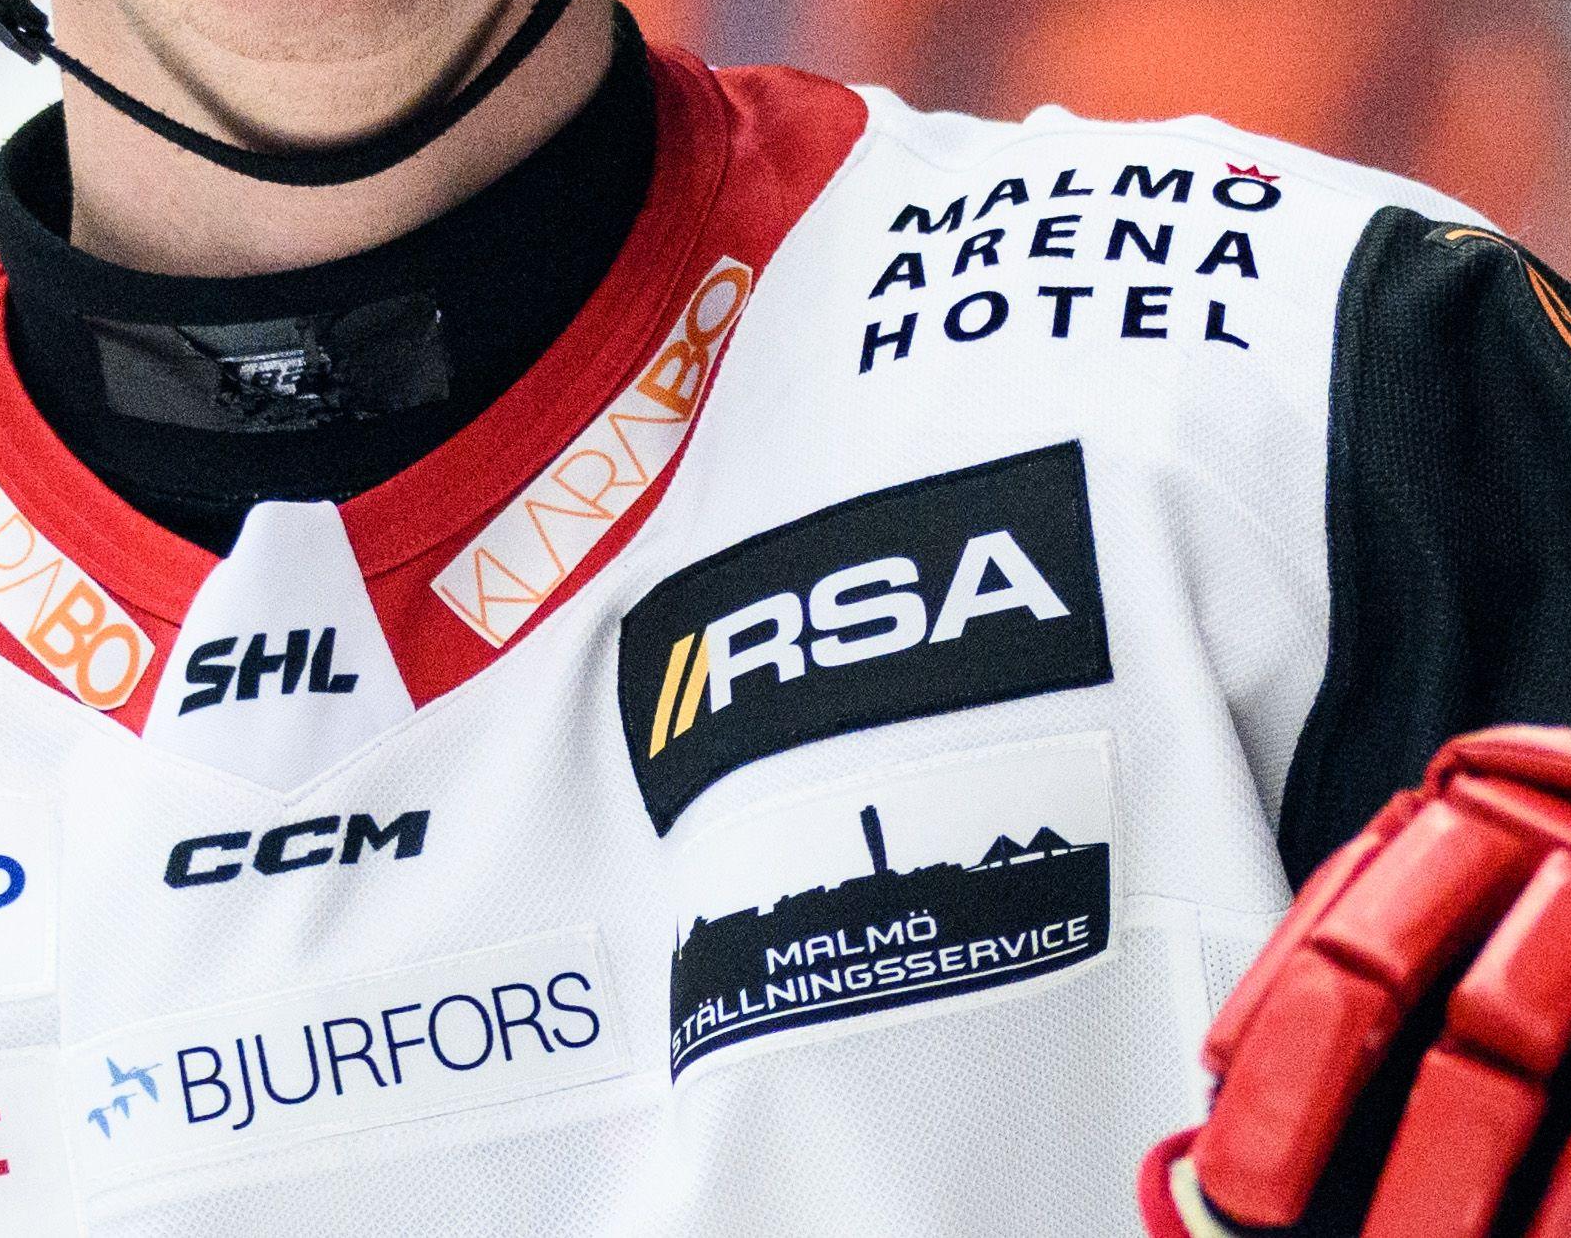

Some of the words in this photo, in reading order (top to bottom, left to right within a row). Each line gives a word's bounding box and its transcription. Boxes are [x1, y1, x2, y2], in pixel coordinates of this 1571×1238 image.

[868, 214, 1259, 300] ARENA
[858, 285, 1250, 376] HOTEL
[440, 266, 752, 647] KLARABO
[706, 530, 1072, 715] RSA
[176, 626, 359, 717] SHL
[163, 809, 431, 890] CCM
[766, 909, 938, 976] MALMÖ
[176, 972, 600, 1131] BJURFORS
